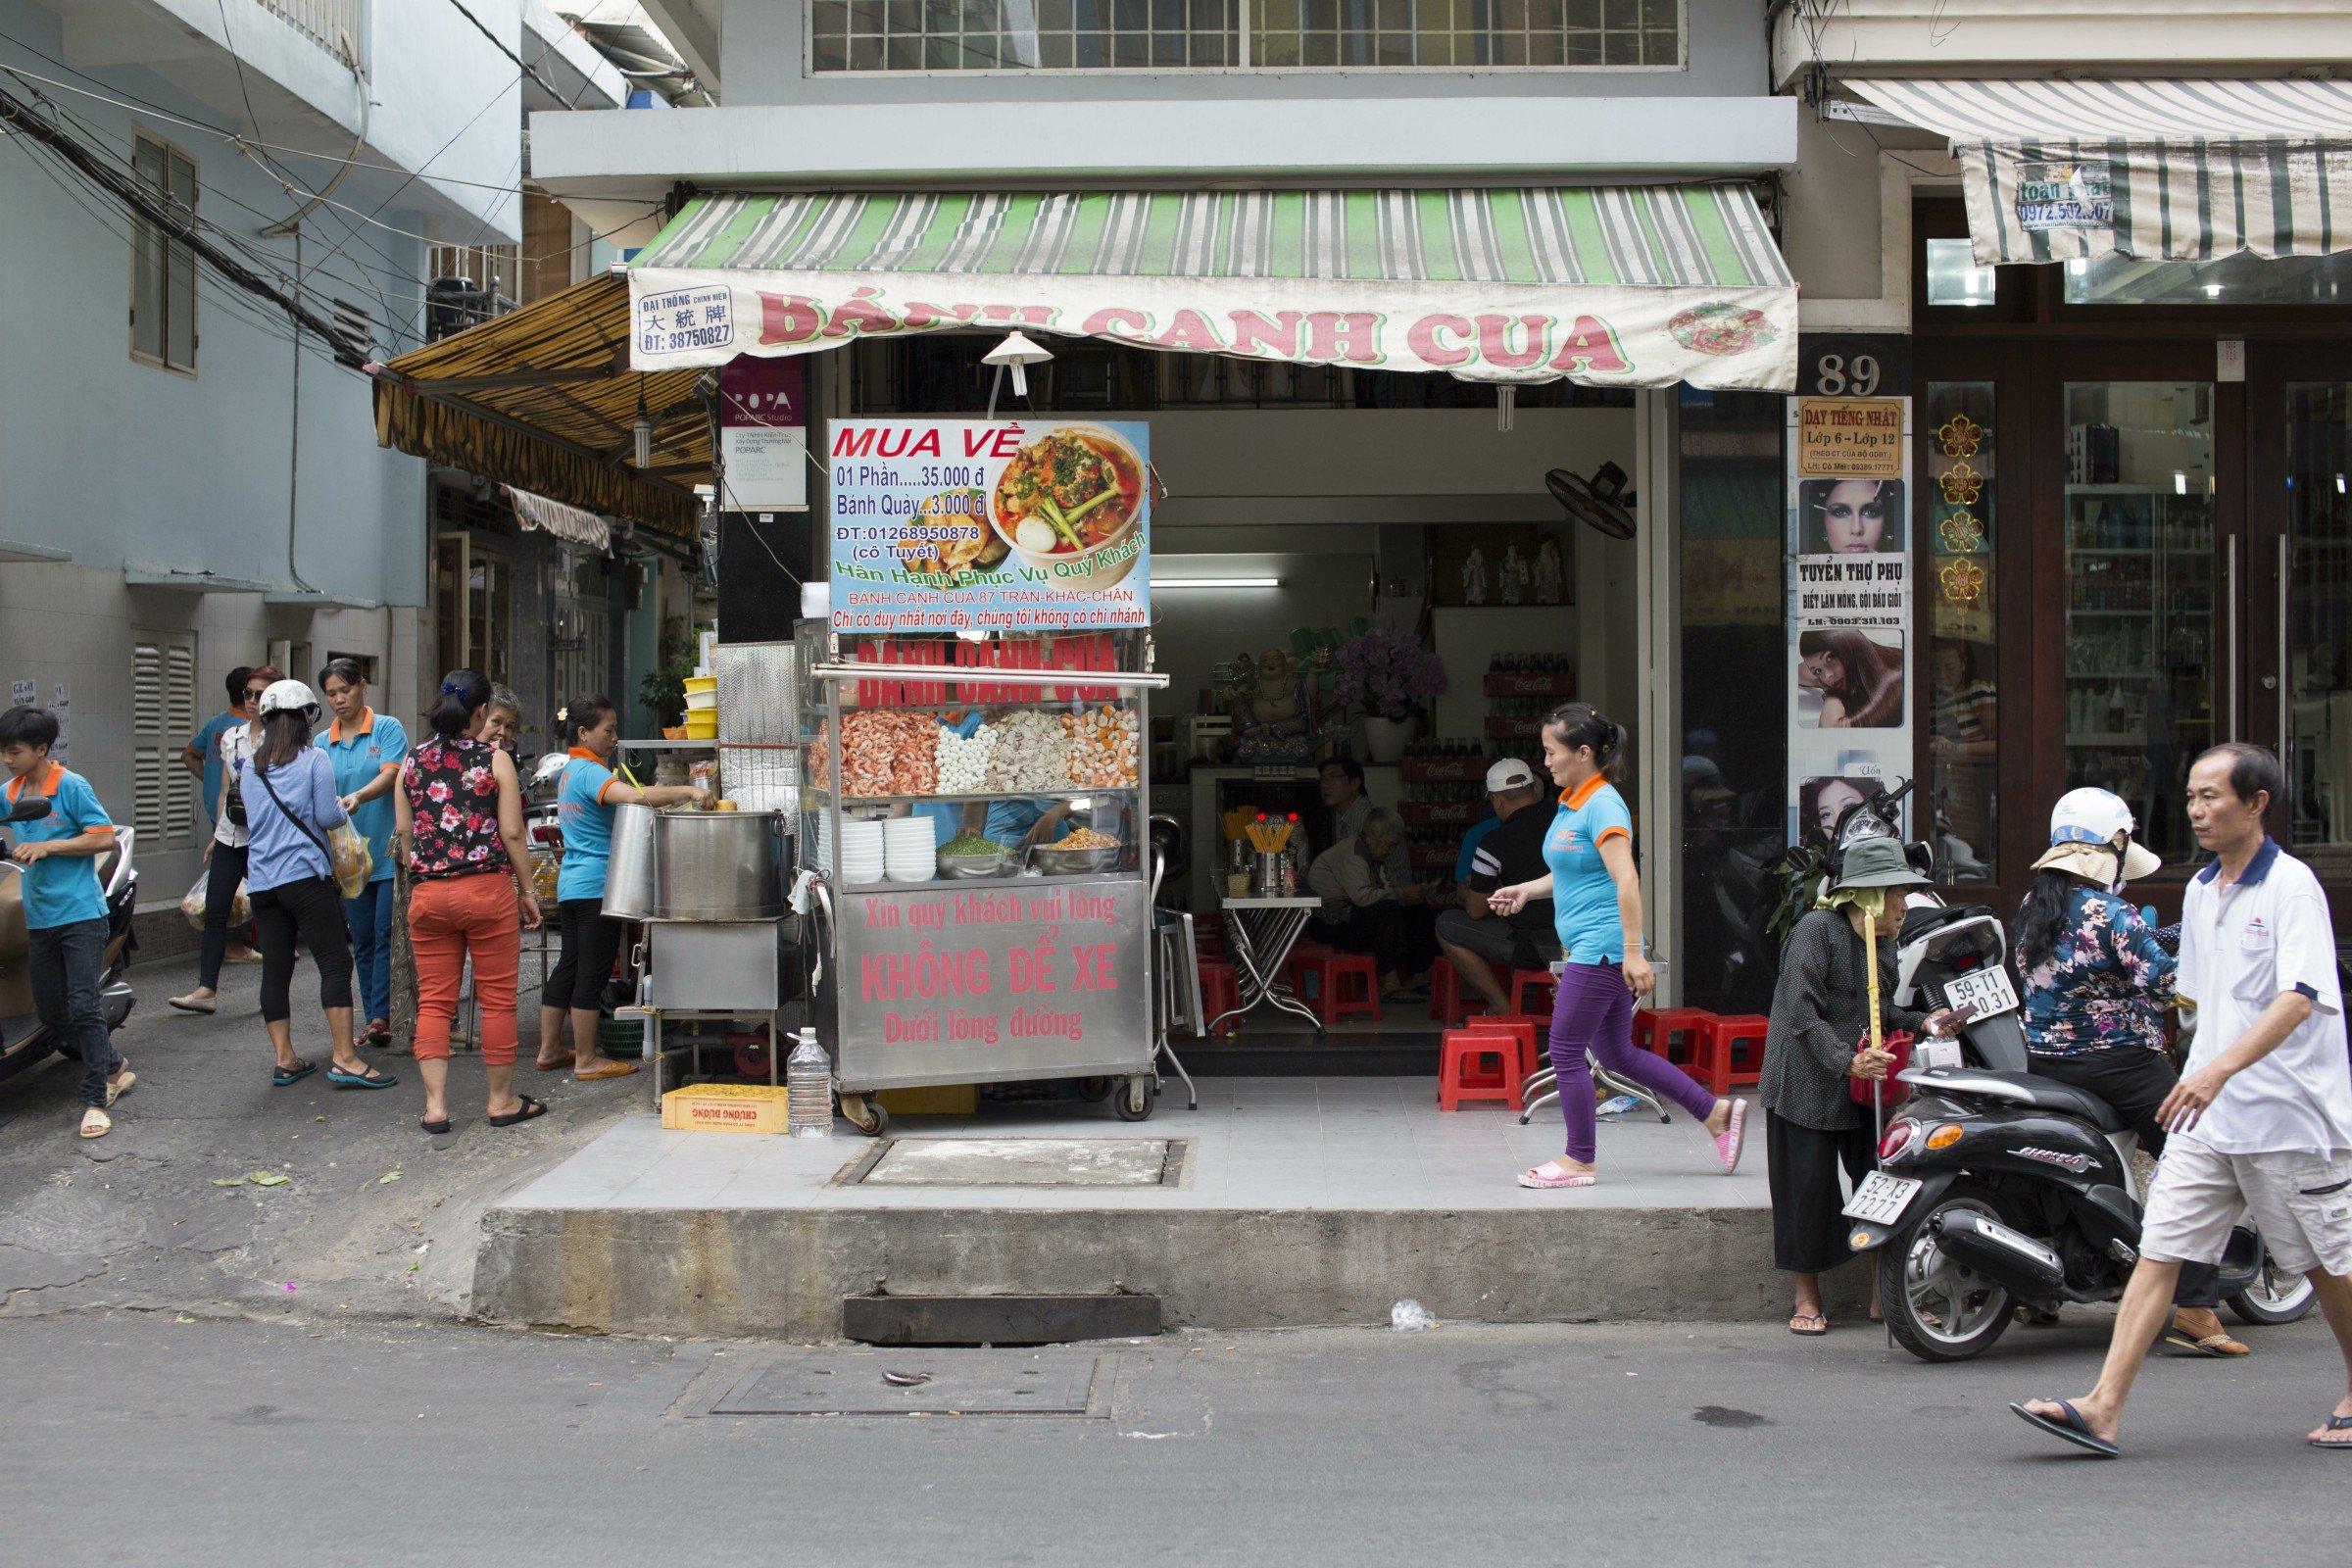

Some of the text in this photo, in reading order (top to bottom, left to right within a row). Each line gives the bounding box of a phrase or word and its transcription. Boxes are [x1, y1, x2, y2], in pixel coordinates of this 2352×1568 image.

[643, 299, 660, 313] ĐẠI
[662, 293, 691, 309] THỐNG
[645, 305, 726, 331] 大統牌
[645, 324, 730, 351] ĐT: 38750827
[1081, 308, 1387, 366] CANH
[1407, 313, 1636, 374] CUA
[1817, 354, 1881, 396] 89
[1805, 409, 1828, 429] DẠY
[1831, 405, 1862, 426] TIẾNG
[1866, 407, 1897, 430] NHẬT
[832, 422, 1026, 458] MUA VỀ
[1807, 431, 1831, 446] Lớp
[1835, 432, 1842, 444] 6
[1854, 432, 1878, 447] Lớp
[1882, 433, 1895, 445] 12
[837, 466, 854, 487] 01
[974, 466, 985, 487] đ
[837, 494, 876, 515] Bánh
[974, 494, 986, 515] đ
[835, 531, 1147, 588] Hân Hạnh Phục Vụ Quý Khách
[853, 543, 939, 562] (cô Tuyết)
[1799, 555, 1903, 585] TUYỂN THỢ PHỤ
[849, 590, 891, 605] BÁNH
[896, 591, 939, 605] CANH
[944, 591, 975, 604] CUA
[978, 591, 996, 604] 87
[833, 606, 1146, 631] Chỉ có duy nhất nơi đây, chúng tôi không có chi nhánh
[864, 889, 1117, 934] Xin quý khách vui lòng
[860, 924, 1119, 1002] KHÔNG ĐỂ XE
[1955, 971, 1998, 1001] 59-T1
[885, 1003, 1083, 1045] Dưới lòng đường
[692, 1108, 758, 1122] CHƯƠNG DƯƠNG
[1866, 1175, 1910, 1199] 52-X3
[1852, 1195, 1897, 1218] 7277
